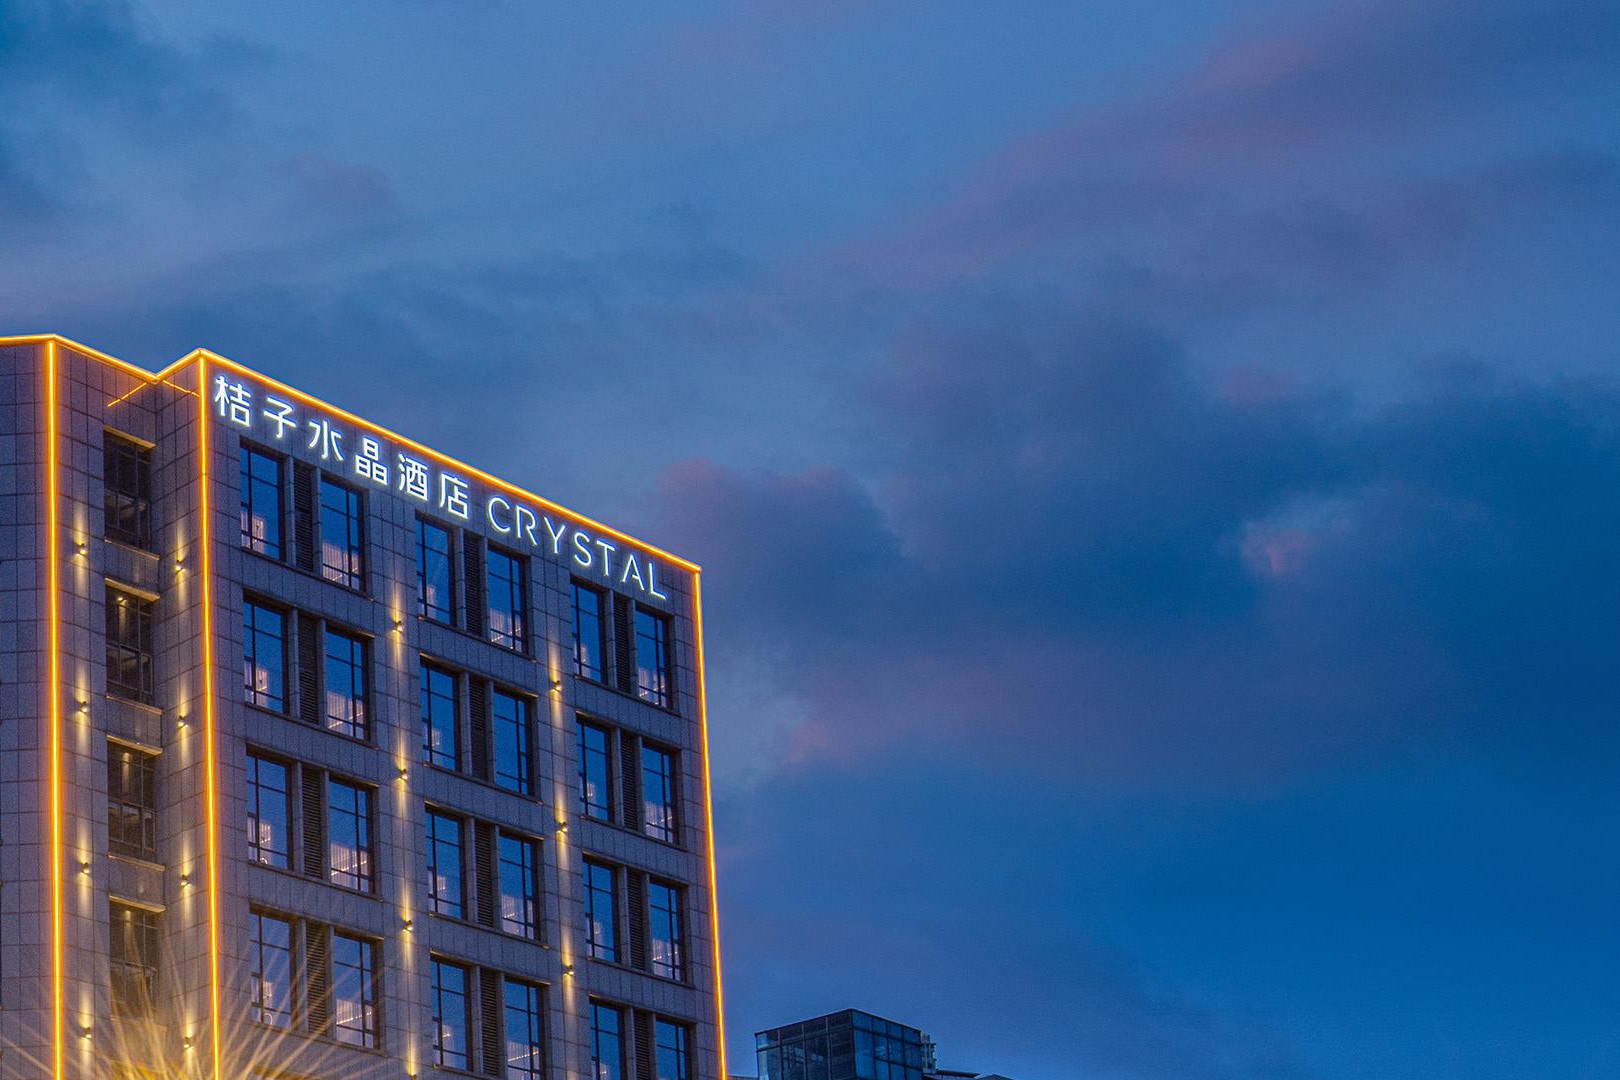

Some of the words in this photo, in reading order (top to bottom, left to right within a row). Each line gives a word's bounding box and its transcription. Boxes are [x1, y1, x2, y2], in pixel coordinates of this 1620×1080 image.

[214, 375, 470, 520] 桔子水晶酒店
[487, 496, 667, 600] CRYSTAL
